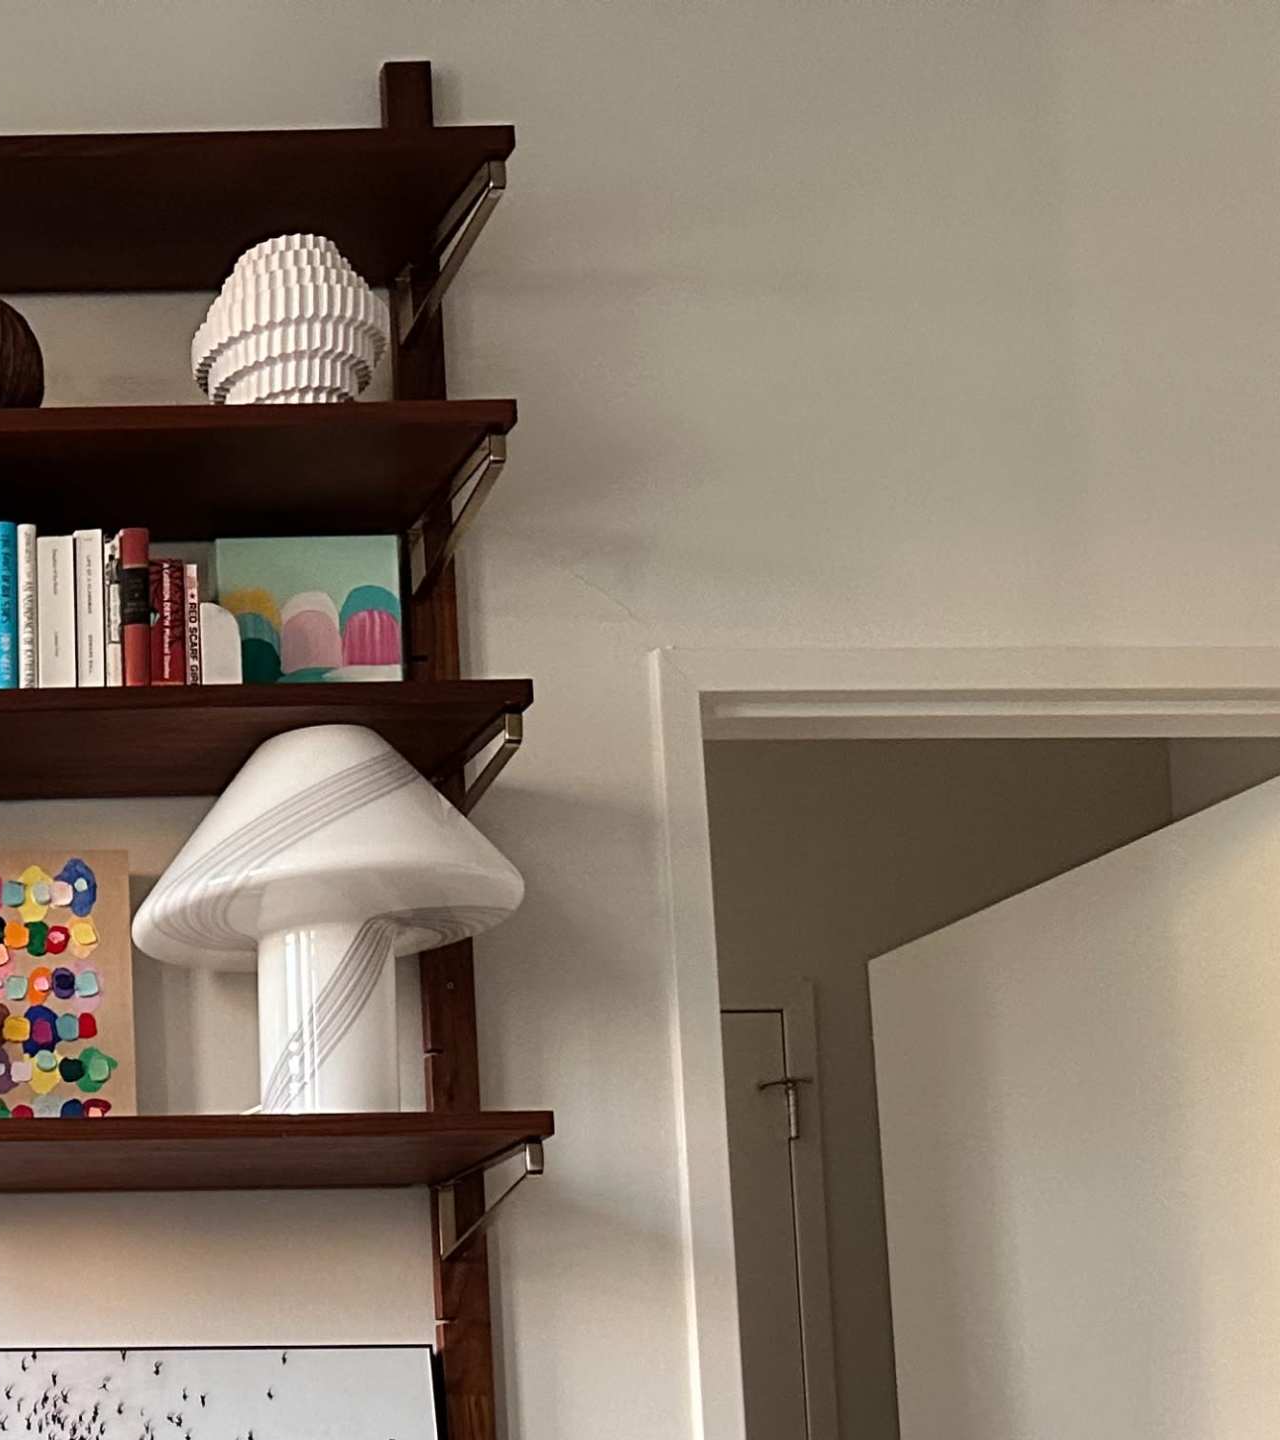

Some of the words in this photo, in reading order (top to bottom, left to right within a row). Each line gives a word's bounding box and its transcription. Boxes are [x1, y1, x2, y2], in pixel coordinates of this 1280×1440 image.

[189, 602, 197, 623] RED
[189, 627, 197, 661] SCARF
[190, 664, 198, 685] GIR
